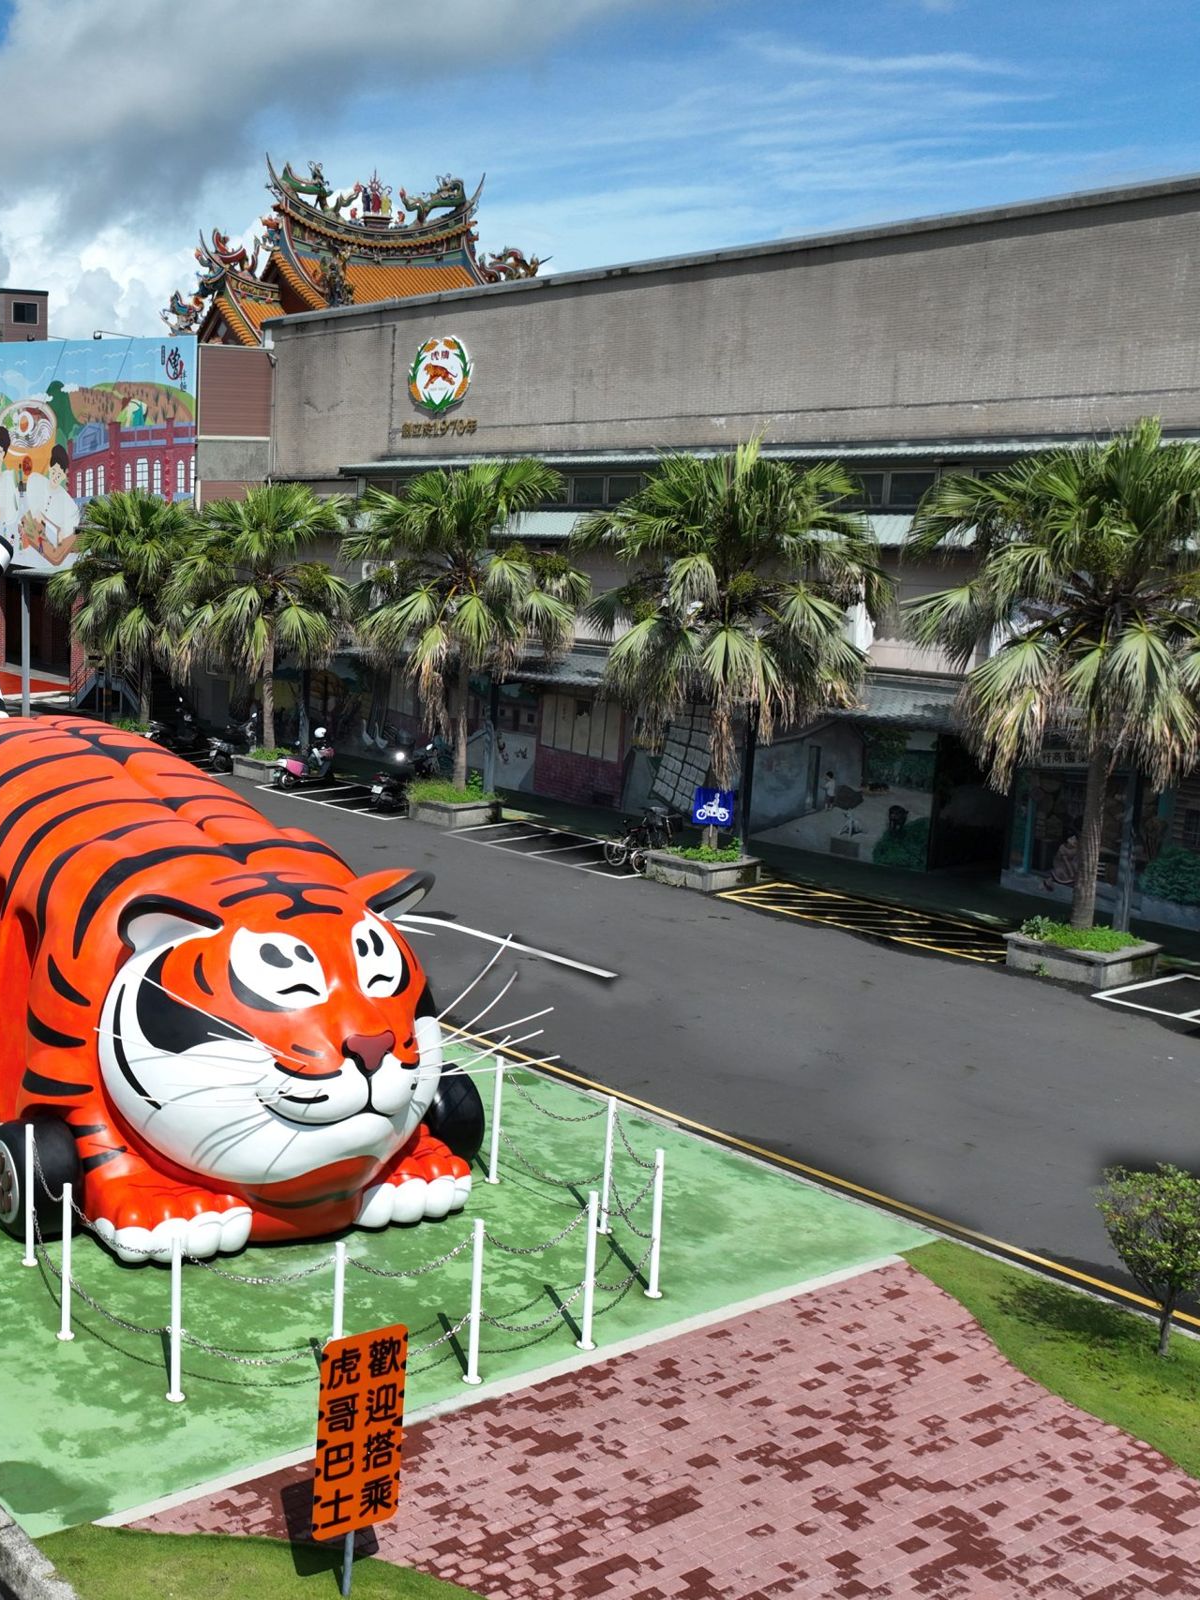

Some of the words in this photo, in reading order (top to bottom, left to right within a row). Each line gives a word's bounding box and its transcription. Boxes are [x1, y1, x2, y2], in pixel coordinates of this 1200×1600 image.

[320, 1347, 362, 1530] 虎哥巴士
[358, 1336, 401, 1518] 歡迎搭乘
